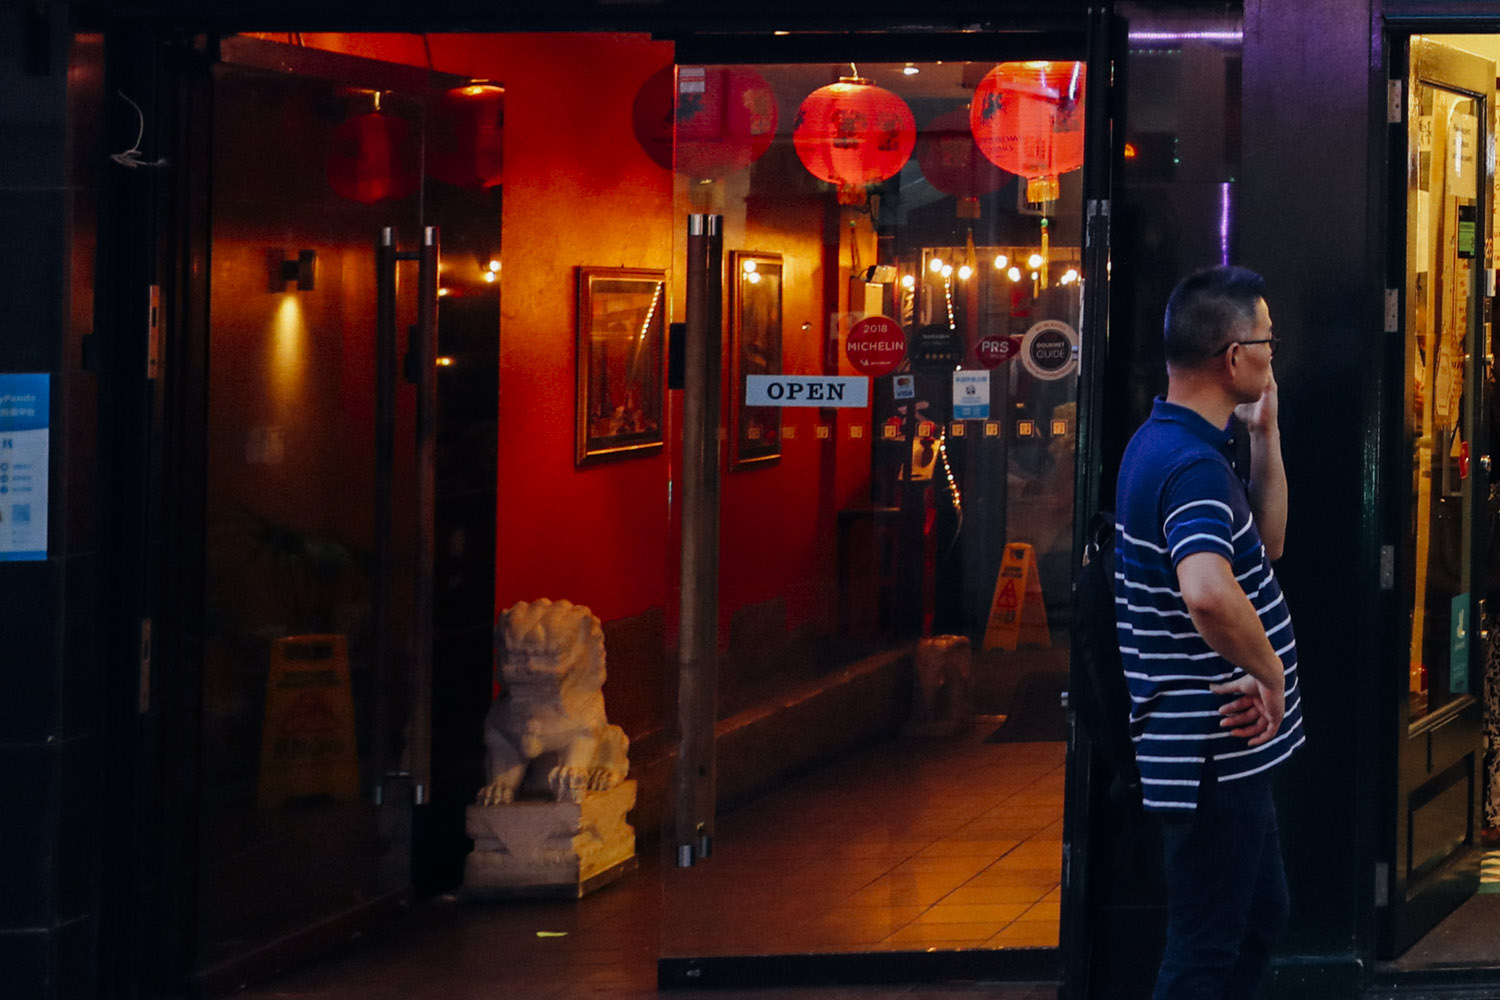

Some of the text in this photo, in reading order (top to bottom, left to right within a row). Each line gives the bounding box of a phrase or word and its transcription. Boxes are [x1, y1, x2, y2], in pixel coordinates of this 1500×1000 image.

[863, 324, 888, 333] 2018
[847, 341, 904, 351] MICHELIN
[981, 341, 1009, 353] PRS
[1036, 349, 1065, 358] GUIDE
[766, 382, 846, 400] OPEN
[897, 389, 913, 397] VISA
